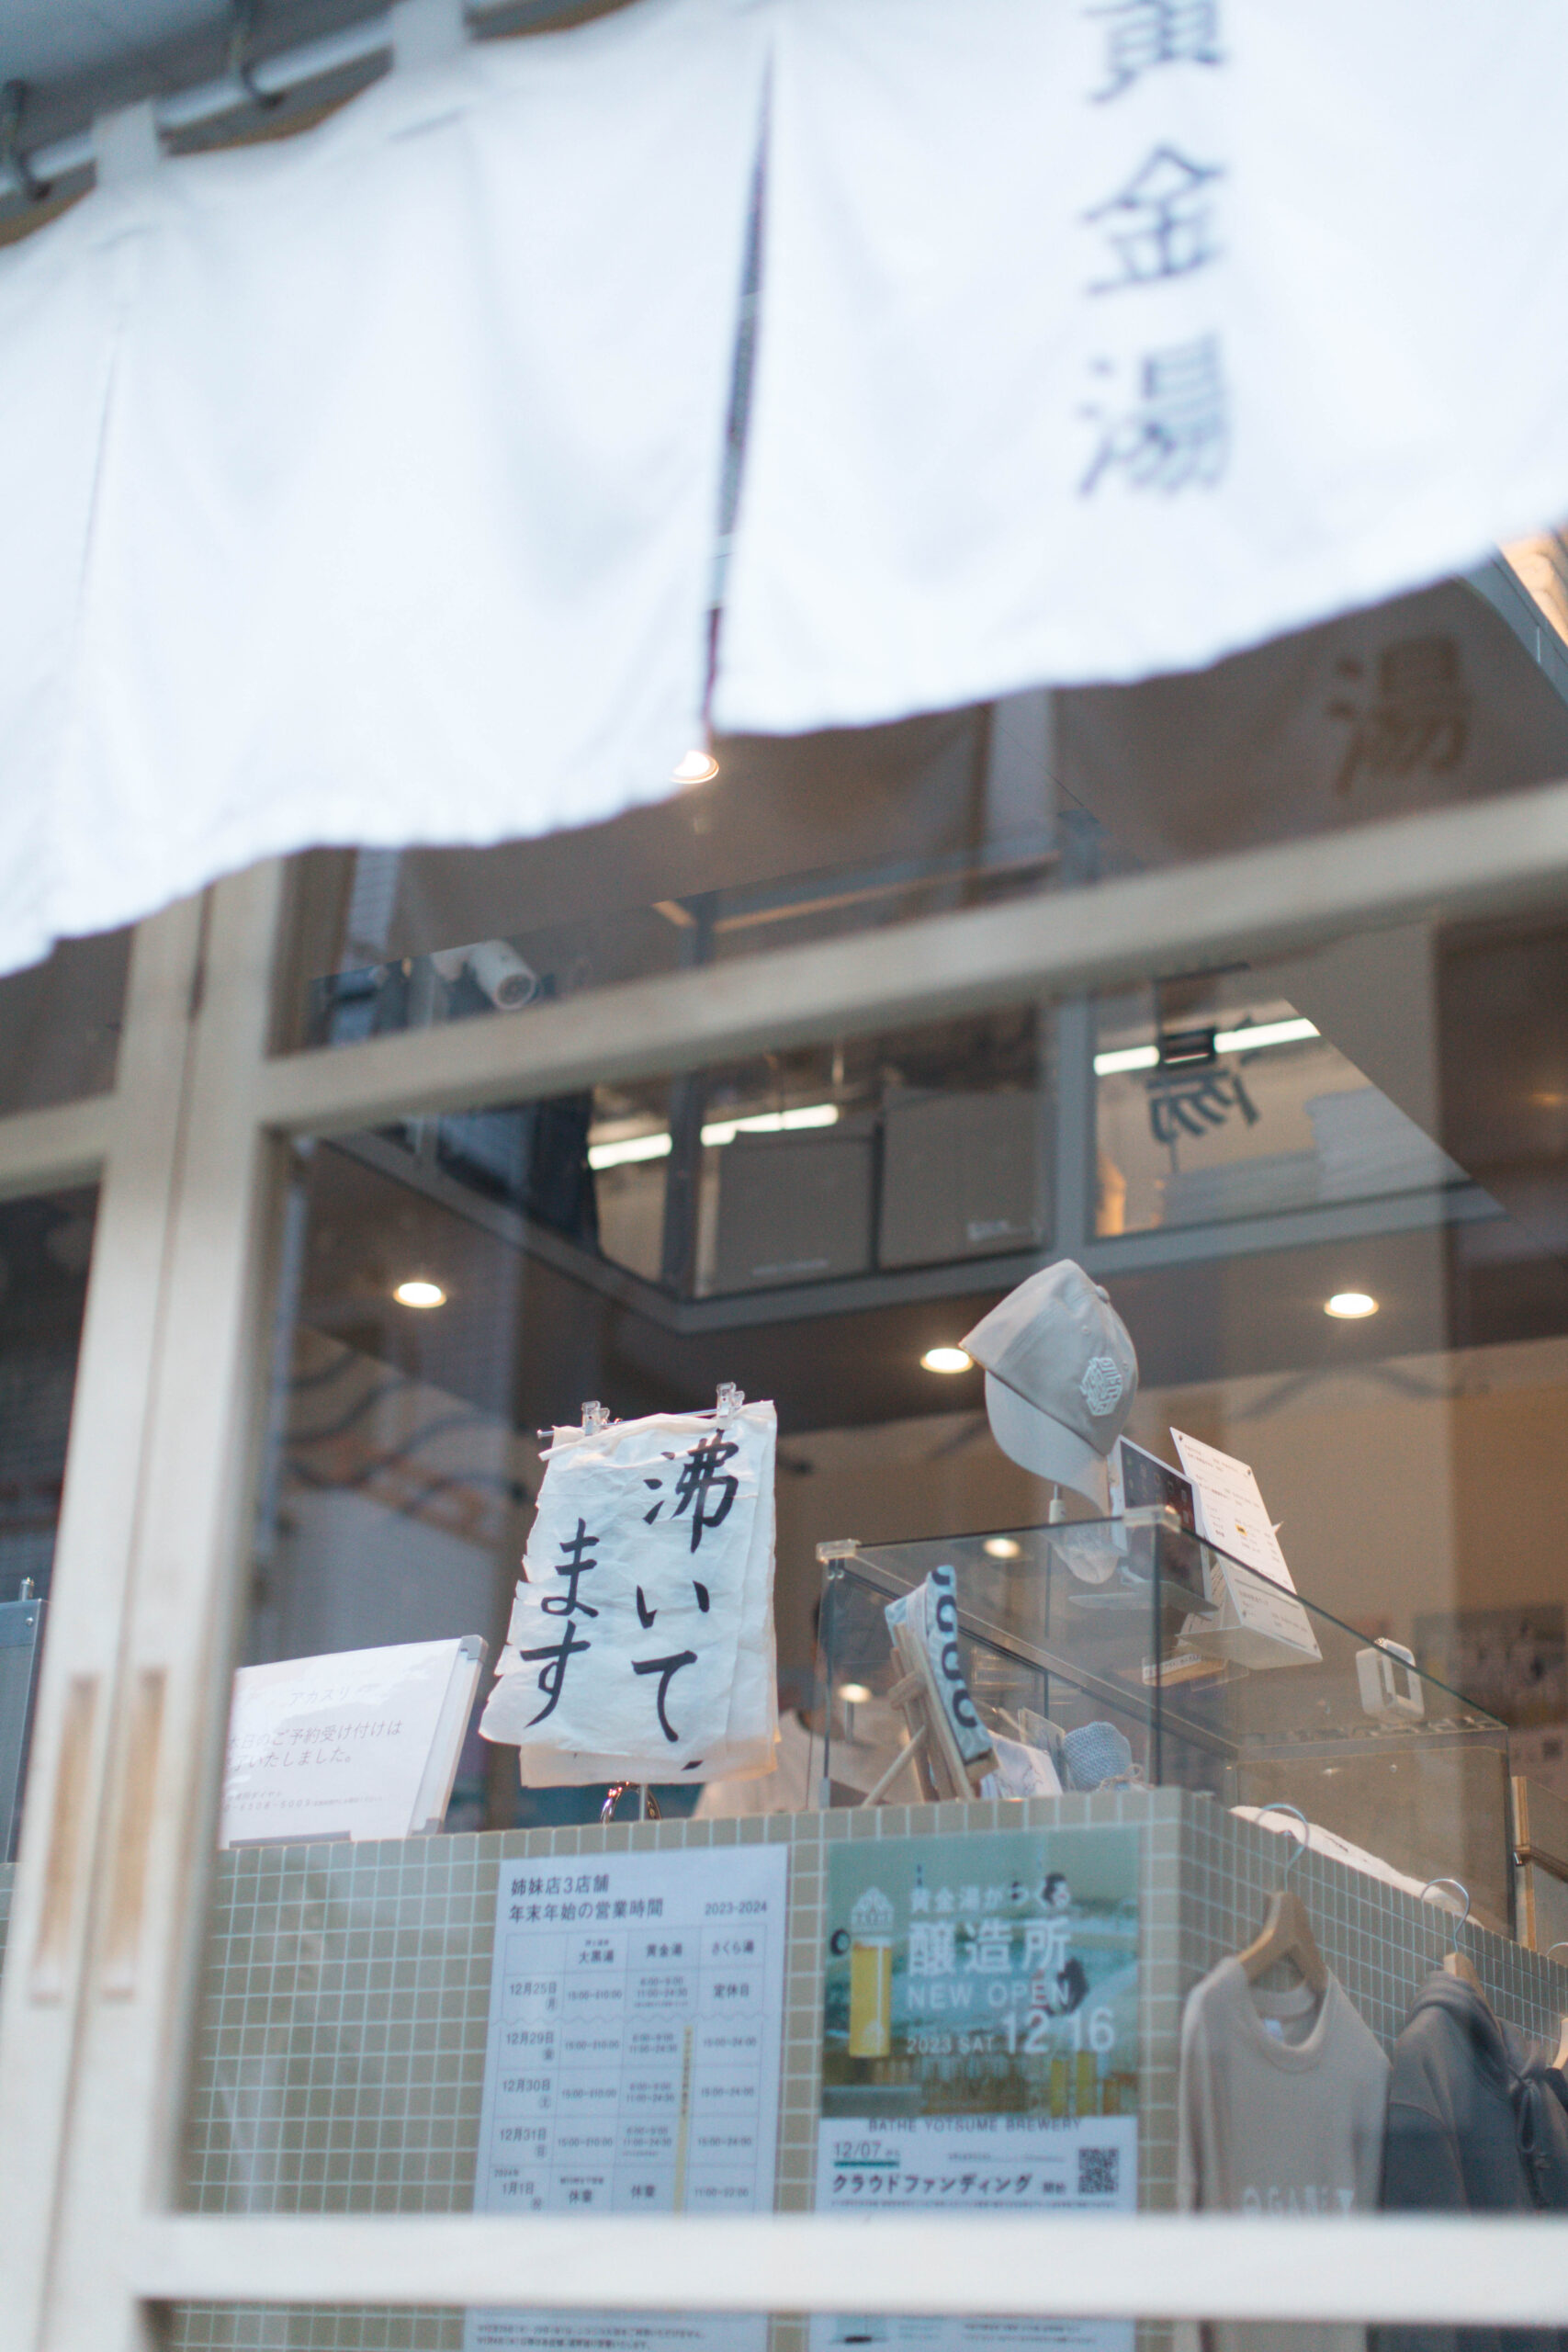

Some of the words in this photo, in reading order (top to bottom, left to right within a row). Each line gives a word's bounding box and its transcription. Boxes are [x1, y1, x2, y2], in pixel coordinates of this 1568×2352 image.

[631, 1430, 739, 1742] 沸いて
[519, 1518, 600, 1728] ます
[226, 1747, 353, 1771] 了いたしました。
[511, 1874, 610, 1896] 姉妹店3店舗
[508, 1898, 663, 1923] 年末年始の営業時間
[705, 1902, 767, 1917] 2023-2024
[908, 1917, 1073, 1977] 醸造所
[510, 1982, 558, 1996] 12月25日
[714, 1984, 750, 1999] 定休日
[908, 1983, 974, 2011] NEW
[987, 1979, 1071, 2009] OPEN
[506, 2030, 554, 2045] 12月29日
[908, 2035, 953, 2055] 2023
[959, 2034, 995, 2054] SAT
[502, 2078, 551, 2093] 12月30日
[869, 2118, 917, 2132] BATHE
[926, 2117, 998, 2132] YOTSUME
[1006, 2116, 1083, 2132] BREWERY
[499, 2128, 547, 2142] 12月31日
[833, 2142, 881, 2159] 12/07
[502, 2182, 534, 2196] 1月1日
[832, 2173, 1034, 2195] クラウドファンディング
